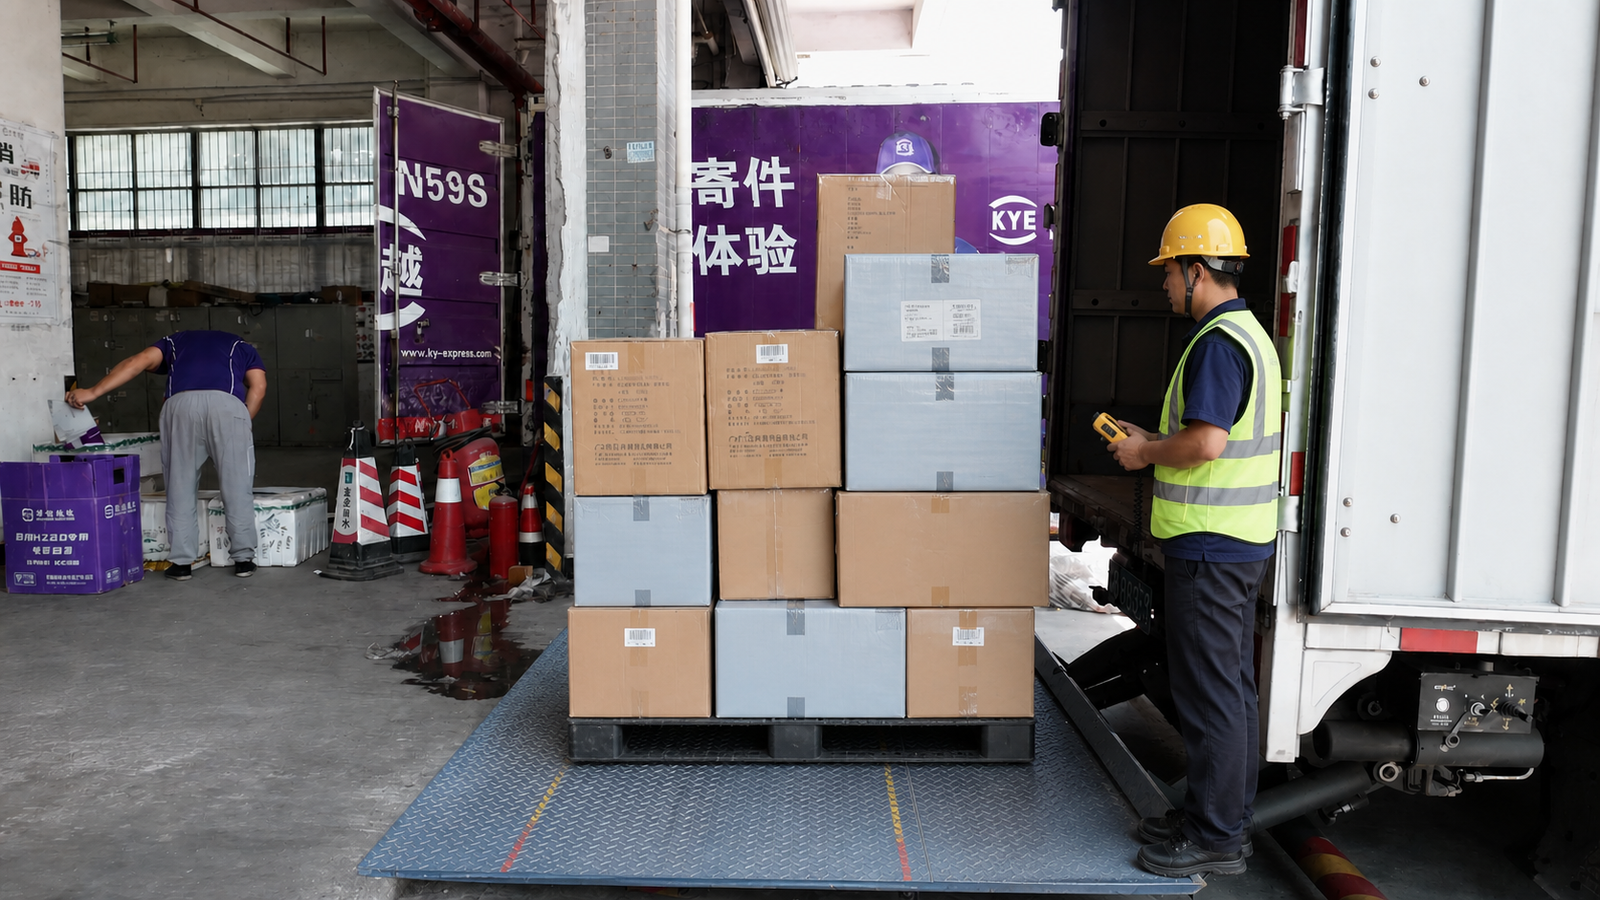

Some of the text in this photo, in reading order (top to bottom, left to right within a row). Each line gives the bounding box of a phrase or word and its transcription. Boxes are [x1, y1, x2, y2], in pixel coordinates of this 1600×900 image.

[397, 159, 488, 208] N59S
[691, 156, 795, 209] 寄件
[992, 210, 1037, 231] KYE
[380, 243, 424, 297] 越
[691, 223, 798, 276] 体验
[400, 348, 493, 360] www.ky-express.com
